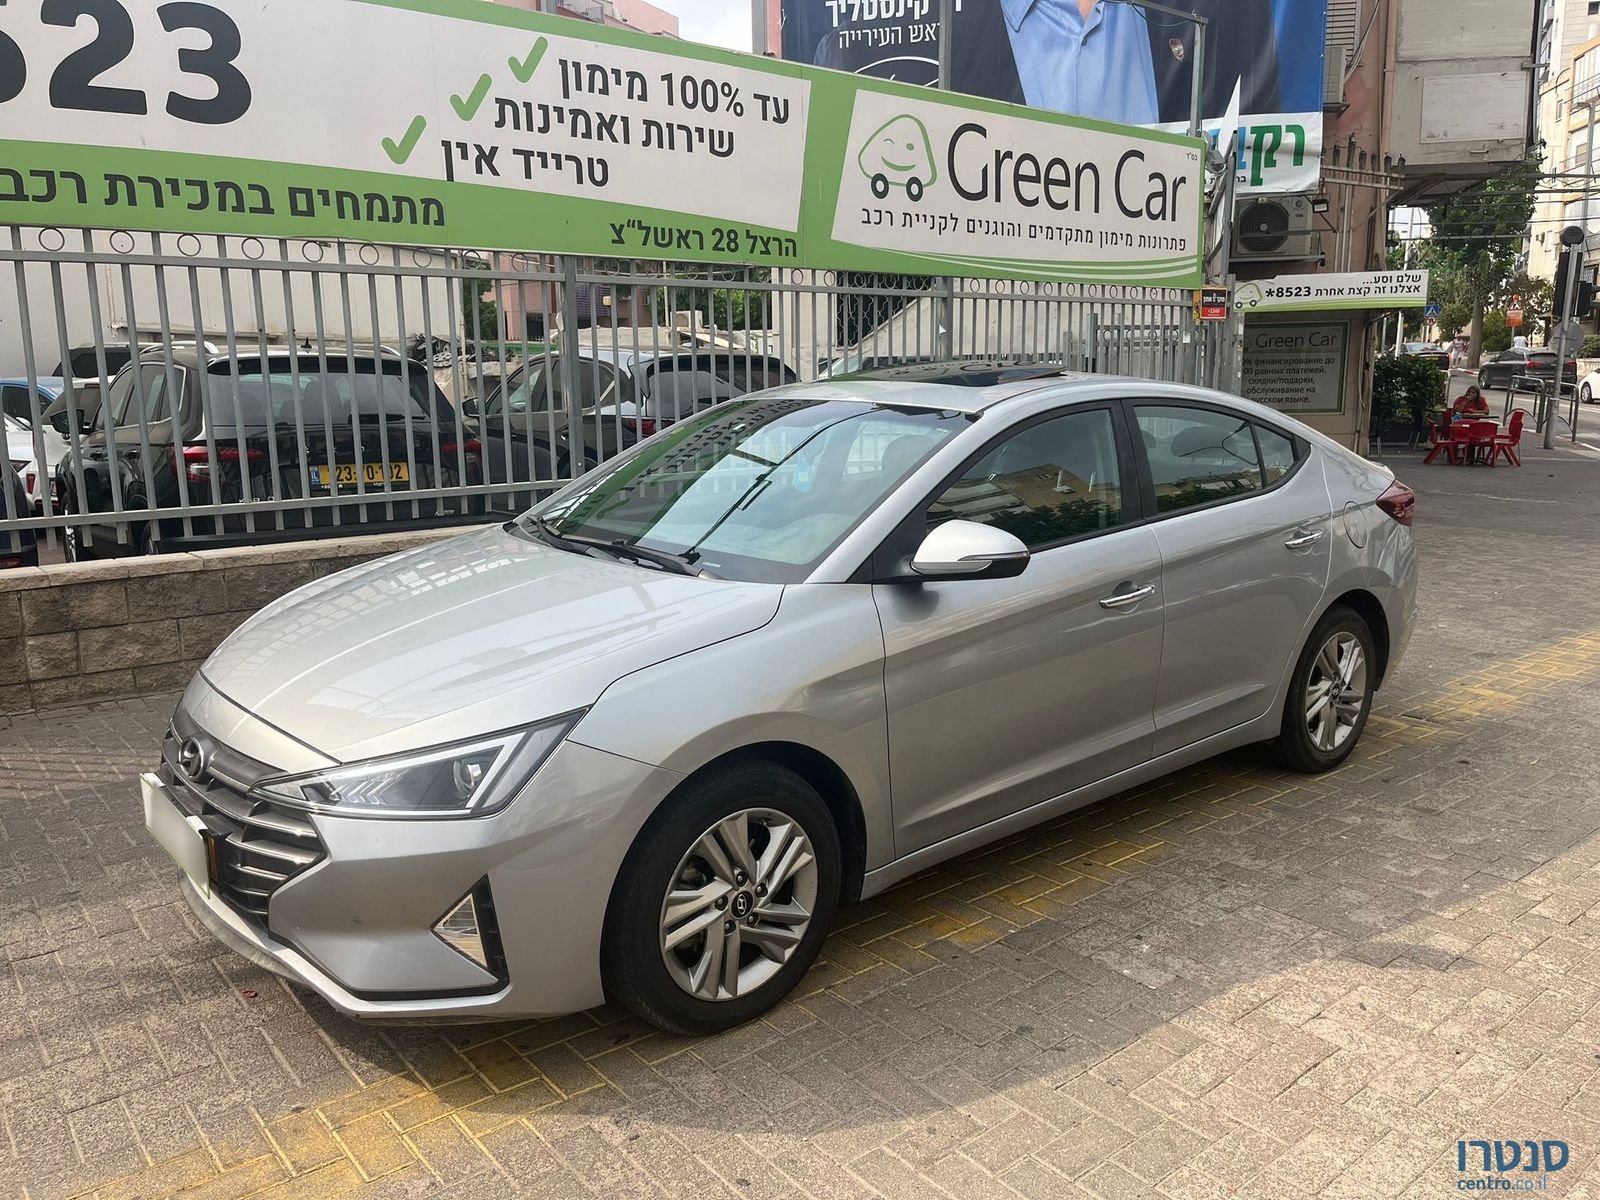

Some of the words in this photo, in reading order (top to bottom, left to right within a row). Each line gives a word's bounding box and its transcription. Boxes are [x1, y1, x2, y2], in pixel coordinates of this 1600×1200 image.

[839, 26, 902, 49] העירייה
[908, 22, 940, 43] אש
[558, 59, 648, 102] מימון
[661, 72, 744, 118] 100%
[494, 97, 631, 145] ואמינות
[753, 93, 790, 125] עד
[641, 118, 735, 158] שירות
[441, 140, 501, 182] אין
[512, 148, 610, 188] טרייד
[948, 122, 1101, 214] Green
[1114, 149, 1187, 223] Car
[0, 168, 88, 204] רכב
[104, 173, 275, 215] במכירת
[289, 186, 446, 227] מתמחים
[861, 207, 894, 227] רכב
[902, 211, 959, 236] לקניית
[966, 217, 1021, 238] והוגנים
[1028, 223, 1093, 246] מתקדמים
[711, 227, 739, 253] 28
[746, 229, 798, 258] הרצל
[1099, 230, 1133, 249] מימון
[1138, 233, 1187, 252] פתרונות
[1374, 285, 1386, 294] זה
[1390, 284, 1420, 294] אצלנו
[1396, 273, 1421, 284] שלם
[1315, 287, 1344, 297] אחרת
[1348, 287, 1371, 297] קצת
[1255, 333, 1304, 348] Green
[1309, 332, 1337, 347] Car
